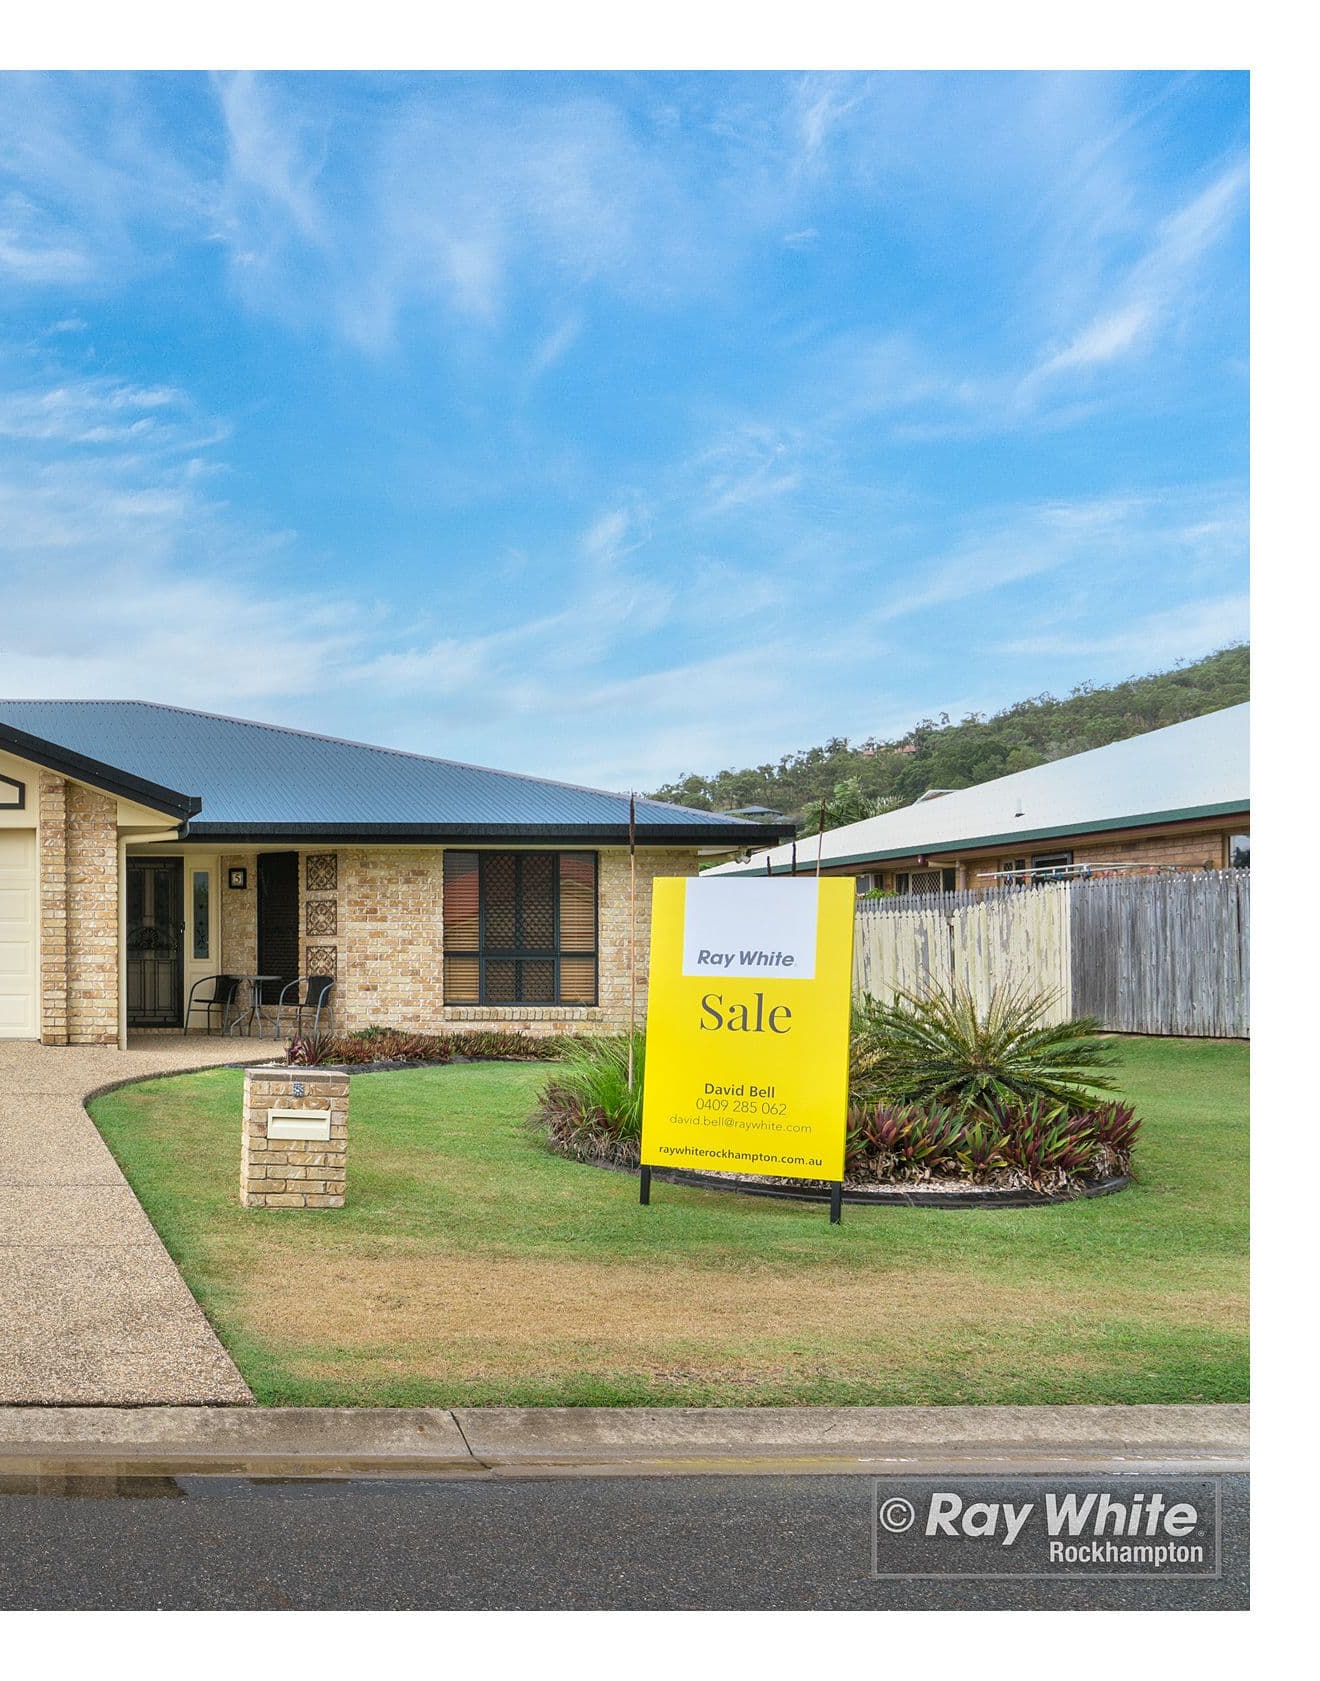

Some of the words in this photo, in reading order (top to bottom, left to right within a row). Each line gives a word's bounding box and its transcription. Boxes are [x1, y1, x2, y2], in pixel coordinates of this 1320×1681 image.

[697, 949, 735, 968] Ray
[739, 951, 794, 966] White
[700, 992, 792, 1034] Sale
[704, 1083, 744, 1096] David
[749, 1085, 775, 1098] Bell
[696, 1098, 728, 1111] 0409
[733, 1100, 757, 1113] 285
[761, 1103, 787, 1115] 062
[669, 1114, 812, 1133] david.bell@raywhite.com
[659, 1145, 822, 1166] raywhiterockhampton.com.au
